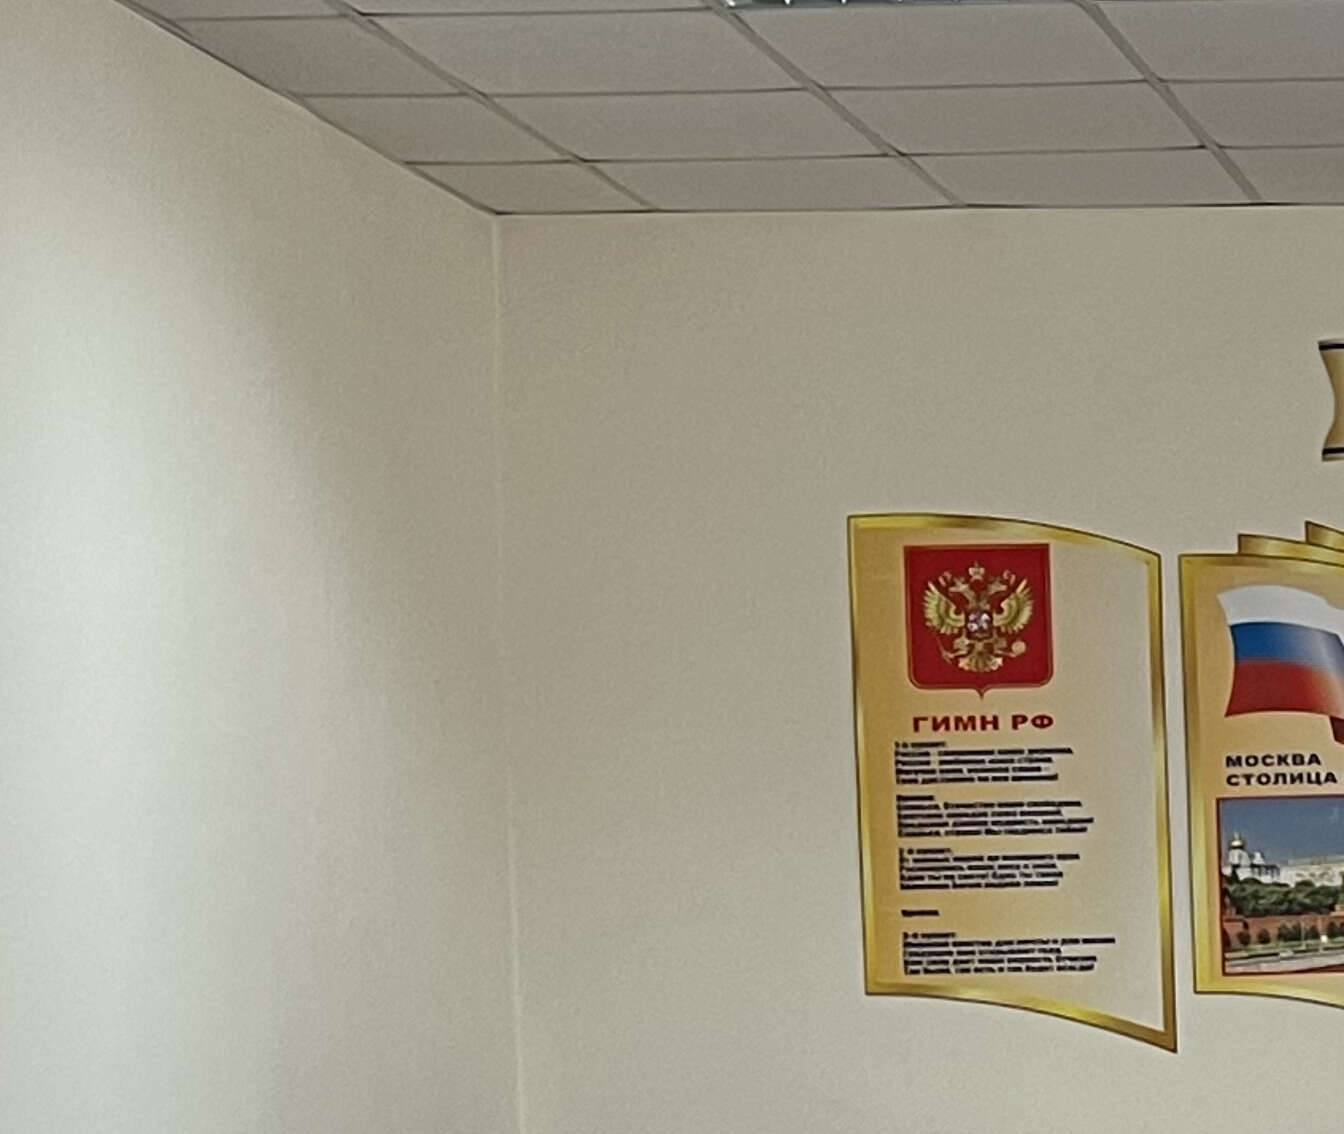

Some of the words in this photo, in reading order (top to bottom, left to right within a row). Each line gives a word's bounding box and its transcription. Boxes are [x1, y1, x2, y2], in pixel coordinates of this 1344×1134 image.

[912, 714, 1000, 733] ГИМН
[1011, 713, 1054, 730] РФ
[1225, 753, 1322, 768] МОСКВА
[1225, 771, 1338, 787] СТОЛИЦА
